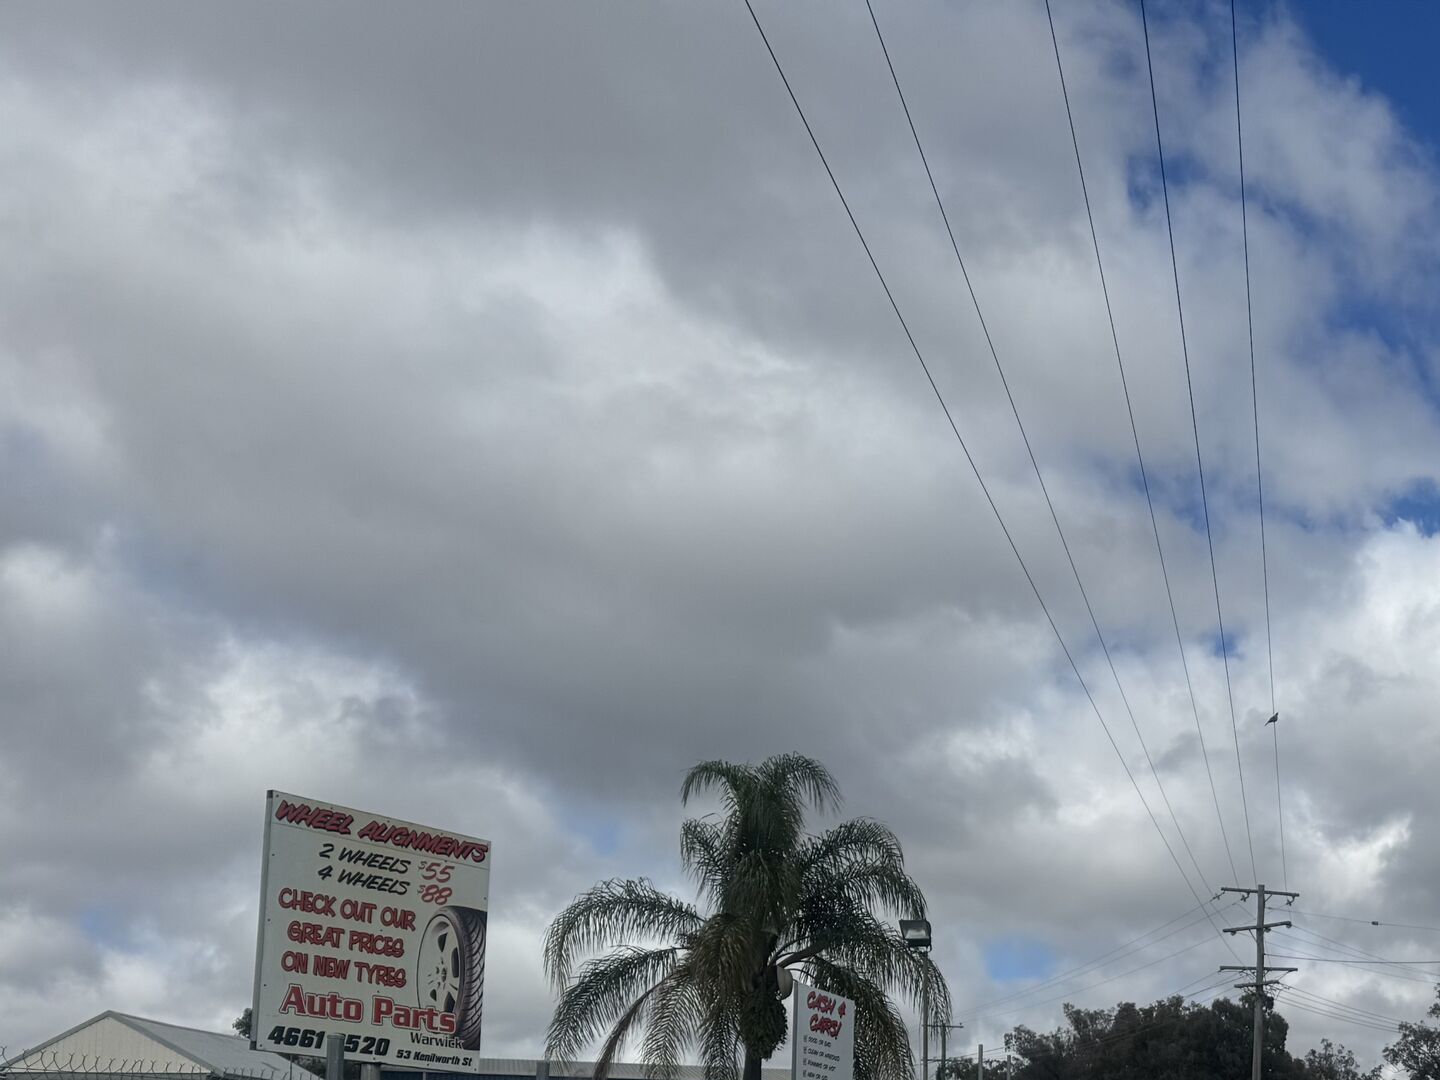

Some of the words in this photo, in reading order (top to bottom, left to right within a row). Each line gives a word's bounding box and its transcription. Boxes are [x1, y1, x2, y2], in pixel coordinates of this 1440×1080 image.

[275, 800, 354, 835] WHEEL
[358, 820, 488, 863] ALIGNMENTS
[319, 843, 334, 859] 2
[339, 848, 411, 875] WHEELS
[417, 860, 455, 884] $55
[318, 865, 333, 881] 4
[337, 870, 410, 895] WHEELS
[417, 884, 452, 906] $88
[278, 888, 335, 917] CHECK
[340, 899, 377, 925] OUT
[381, 908, 417, 931] OUR
[287, 921, 344, 947] GREAT
[349, 931, 404, 958] PRICES
[281, 951, 308, 974] ON
[313, 956, 350, 979] NEW
[354, 961, 407, 988] TYRES
[279, 984, 363, 1023] Auto
[372, 993, 458, 1034] Parts
[807, 991, 836, 1016] CASH
[267, 1025, 326, 1049] 4661
[337, 1033, 390, 1056] 520
[410, 1032, 464, 1050] Warwick
[397, 1048, 411, 1060] 53
[413, 1050, 460, 1066] Kenilworth
[462, 1056, 473, 1067] St
